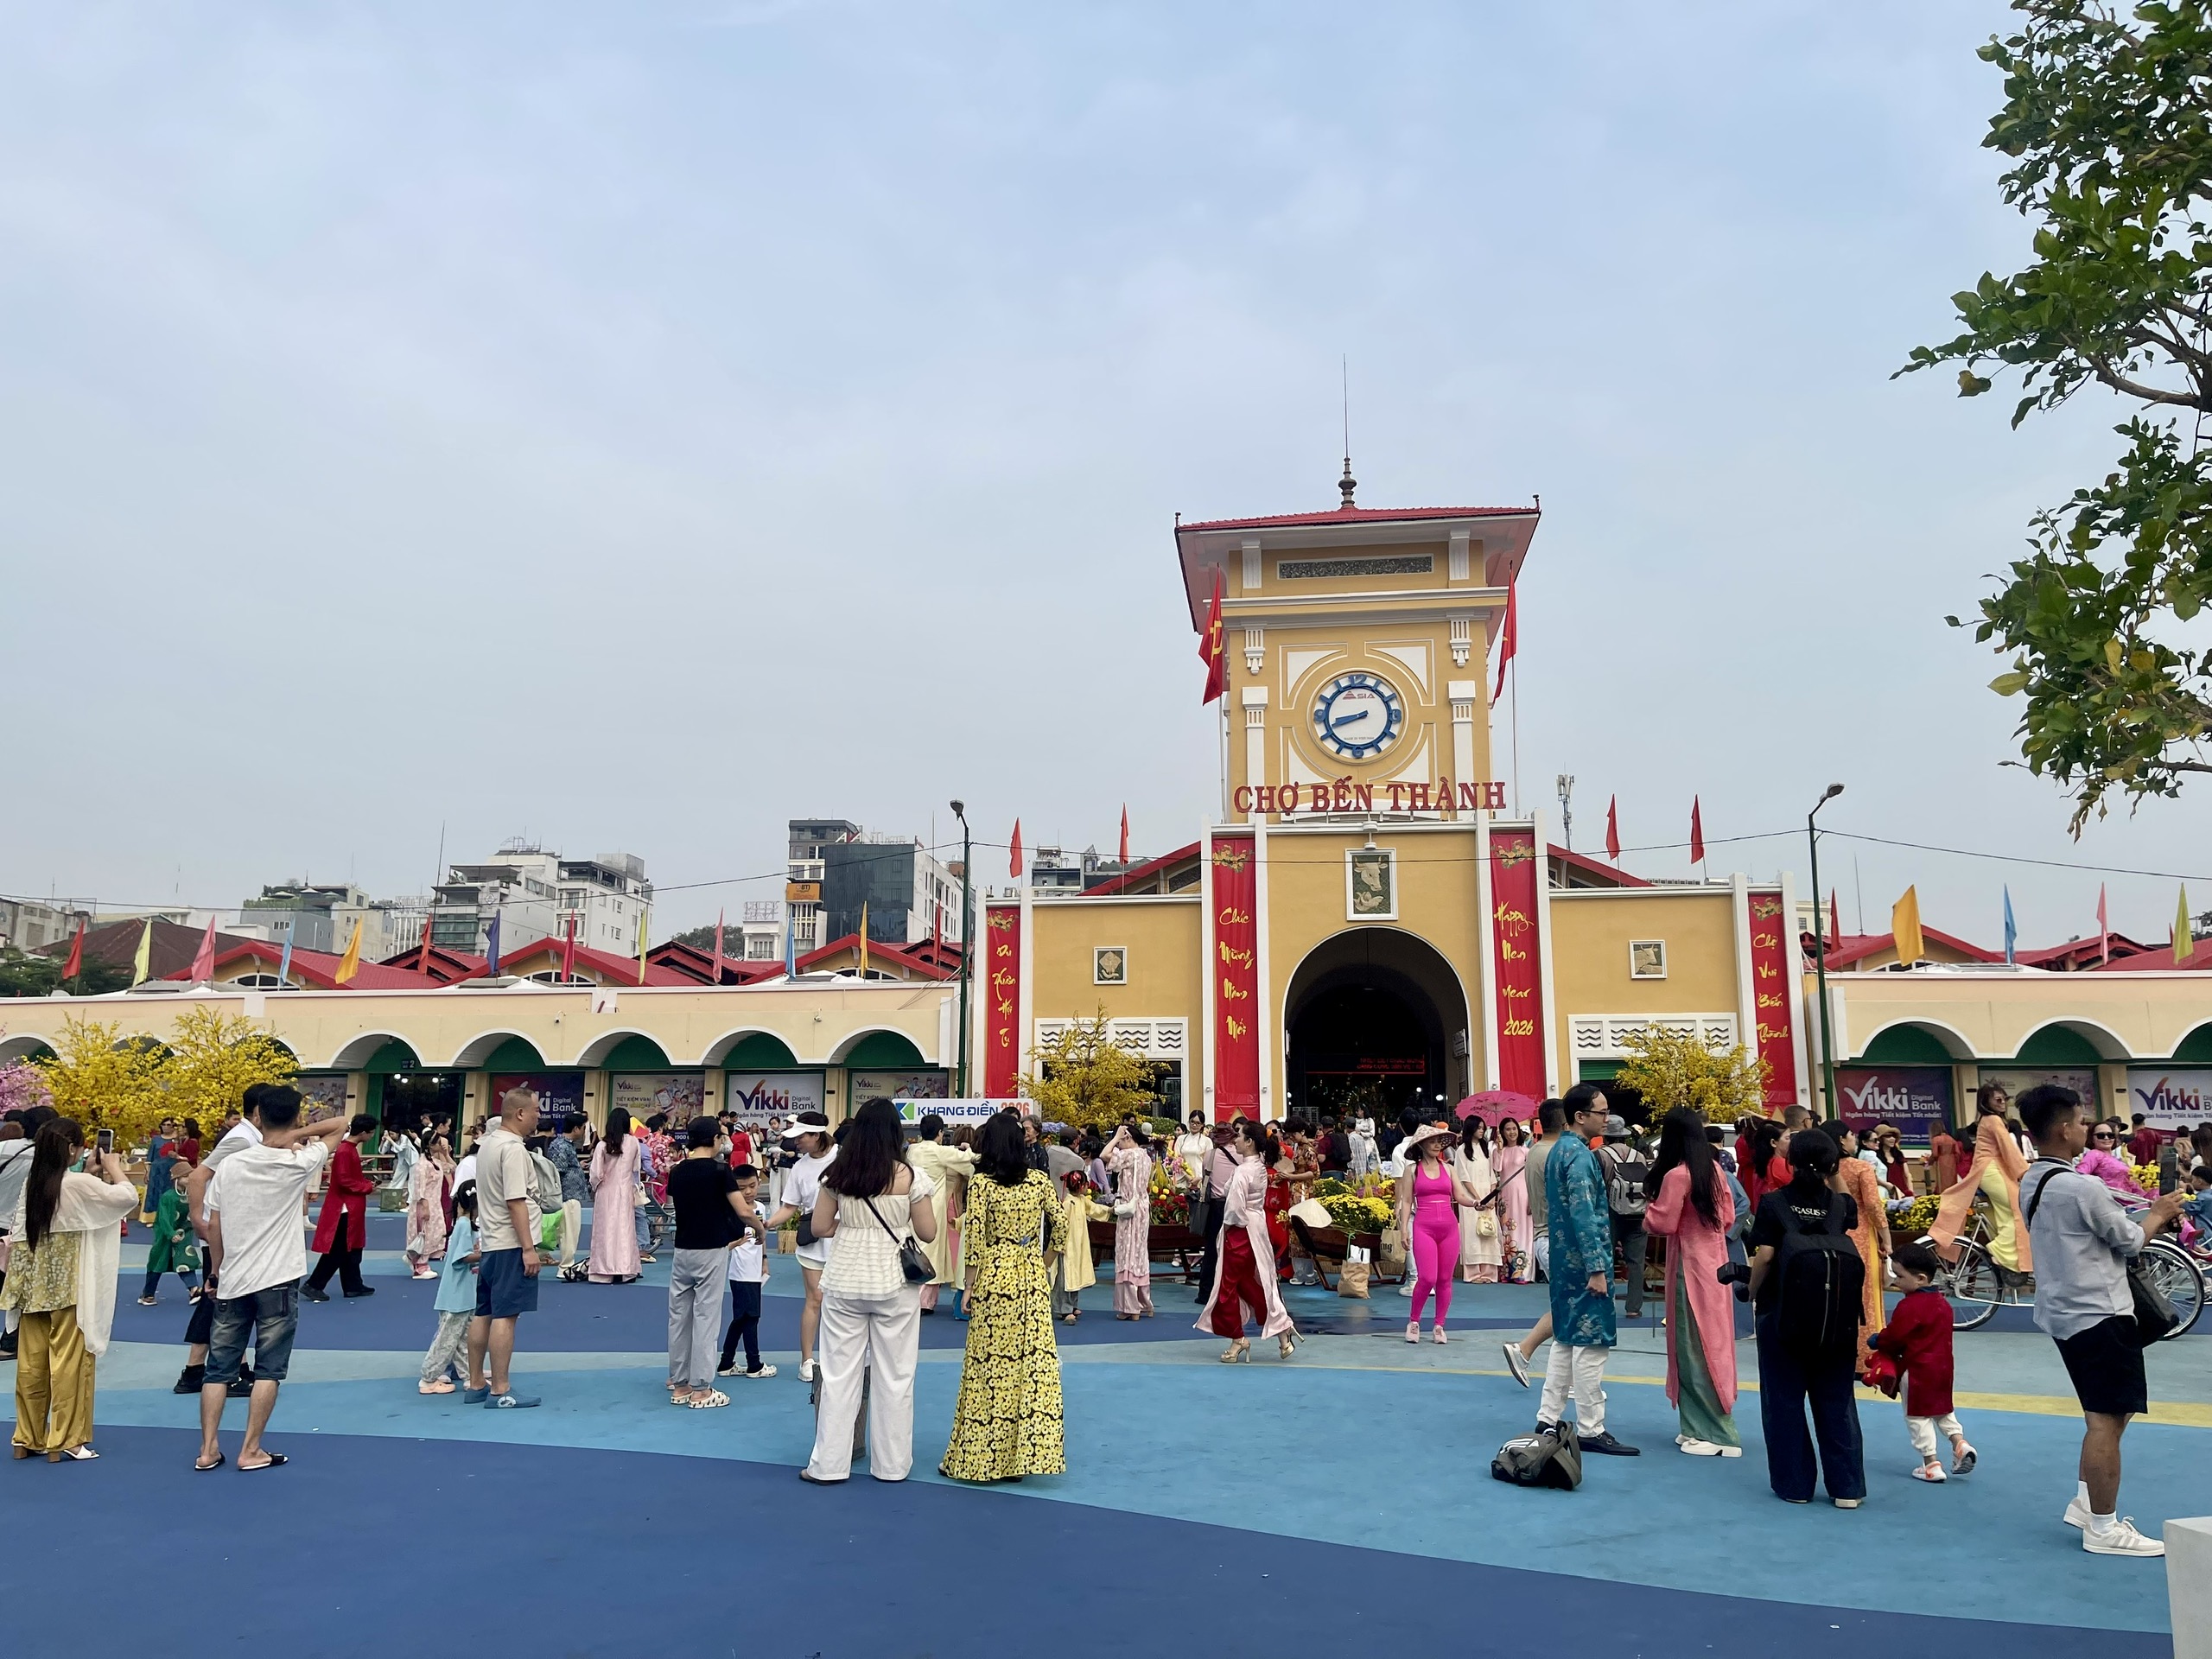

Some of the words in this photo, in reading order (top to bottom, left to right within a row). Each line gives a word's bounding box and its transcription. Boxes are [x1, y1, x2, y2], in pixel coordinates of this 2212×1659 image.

[1348, 674, 1367, 686] 12
[1390, 709, 1402, 723] 3
[1352, 747, 1363, 759] 6
[1234, 781, 1299, 816] CHỢ
[1311, 775, 1373, 812] BẾN
[1386, 776, 1507, 810] THÀNH
[1219, 906, 1250, 925] Chúc
[1493, 900, 1535, 937] Happy
[1753, 932, 1778, 950] Chợ
[1758, 960, 1777, 979] Vui
[1502, 984, 1533, 1023] Year
[1758, 992, 1783, 1008] Bến
[1503, 1019, 1534, 1036] 2026
[1756, 1022, 1789, 1044] Thành
[410, 1059, 415, 1068] 2
[735, 1078, 790, 1110] Vikki
[1843, 1076, 1909, 1110] Vikki
[2135, 1077, 2200, 1110] Vikki
[552, 1103, 576, 1112] Bank
[791, 1102, 817, 1110] Bank
[918, 1106, 964, 1116] KHANG
[966, 1100, 999, 1116] ĐIỀN
[1911, 1101, 1942, 1110] Bank
